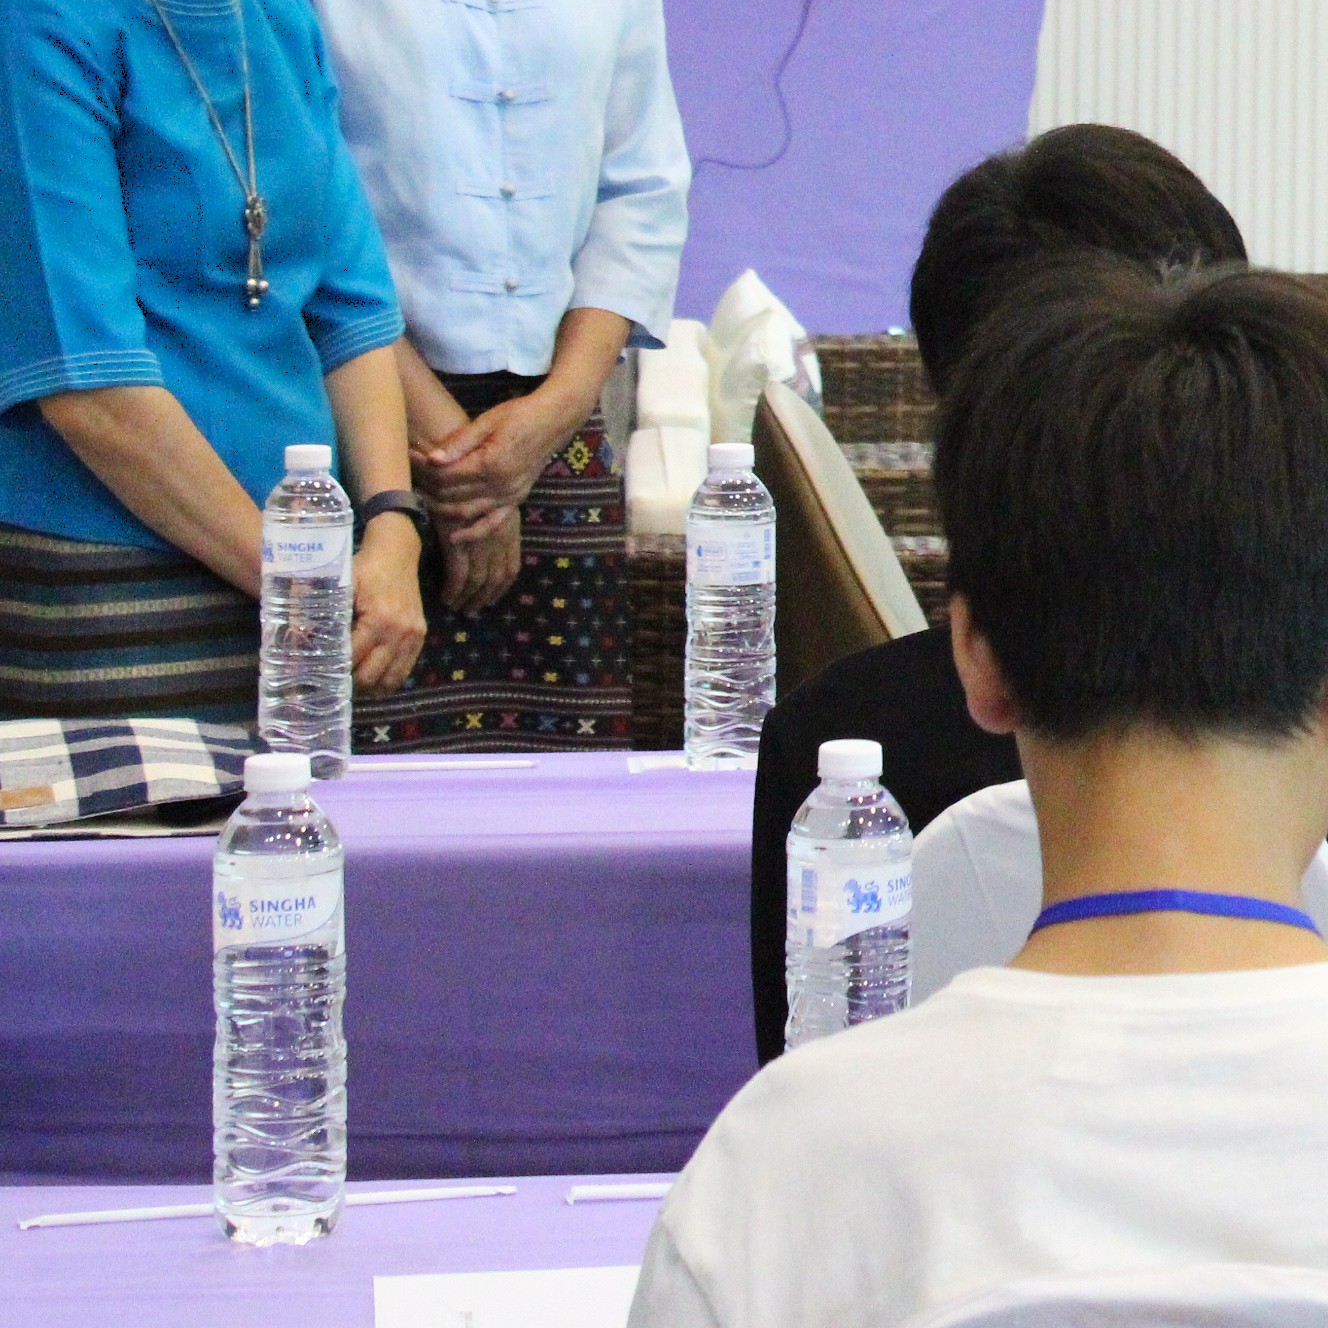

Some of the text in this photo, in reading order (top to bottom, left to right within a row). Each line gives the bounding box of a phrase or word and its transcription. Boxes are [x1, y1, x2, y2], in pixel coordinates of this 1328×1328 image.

[277, 542, 324, 552] SINGHA
[249, 896, 316, 913] SINGHA
[251, 913, 303, 928] WATER
